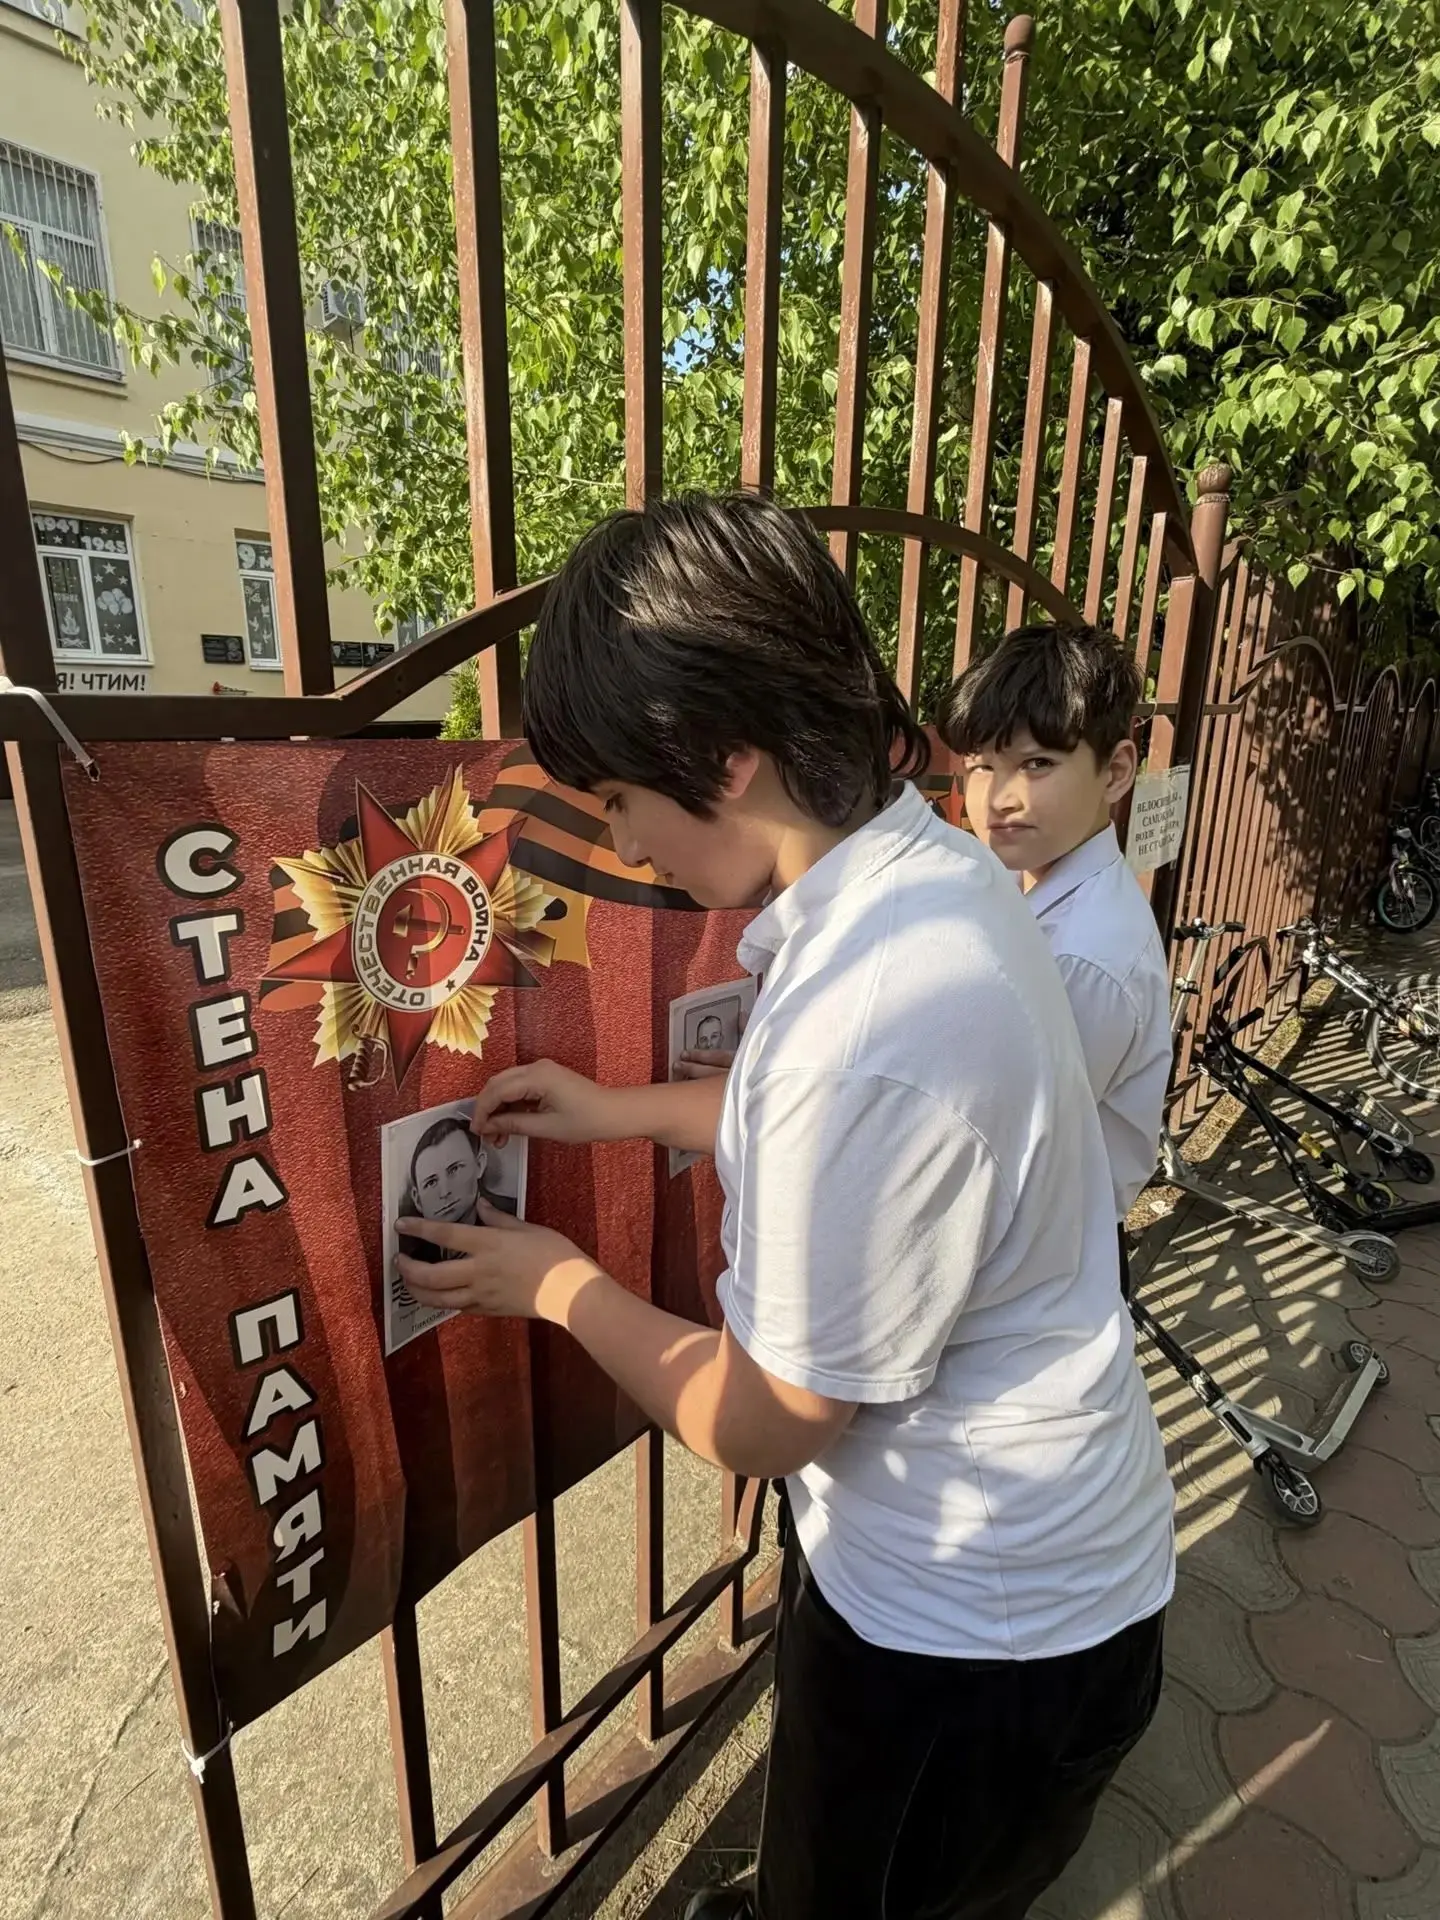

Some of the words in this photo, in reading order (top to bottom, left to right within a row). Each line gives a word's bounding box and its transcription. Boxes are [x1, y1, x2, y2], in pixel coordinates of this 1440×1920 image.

[34, 516, 79, 534] 1941
[81, 536, 126, 554] 1945
[238, 544, 256, 569] 9
[82, 674, 145, 691] ЧТИМ!
[359, 857, 461, 1006] ОТЕЧЕСТВЕННАЯ
[462, 875, 489, 962] ВОЙНА
[160, 826, 287, 1226] СТЕНА
[231, 1291, 327, 1659] ПАМЯТИ
